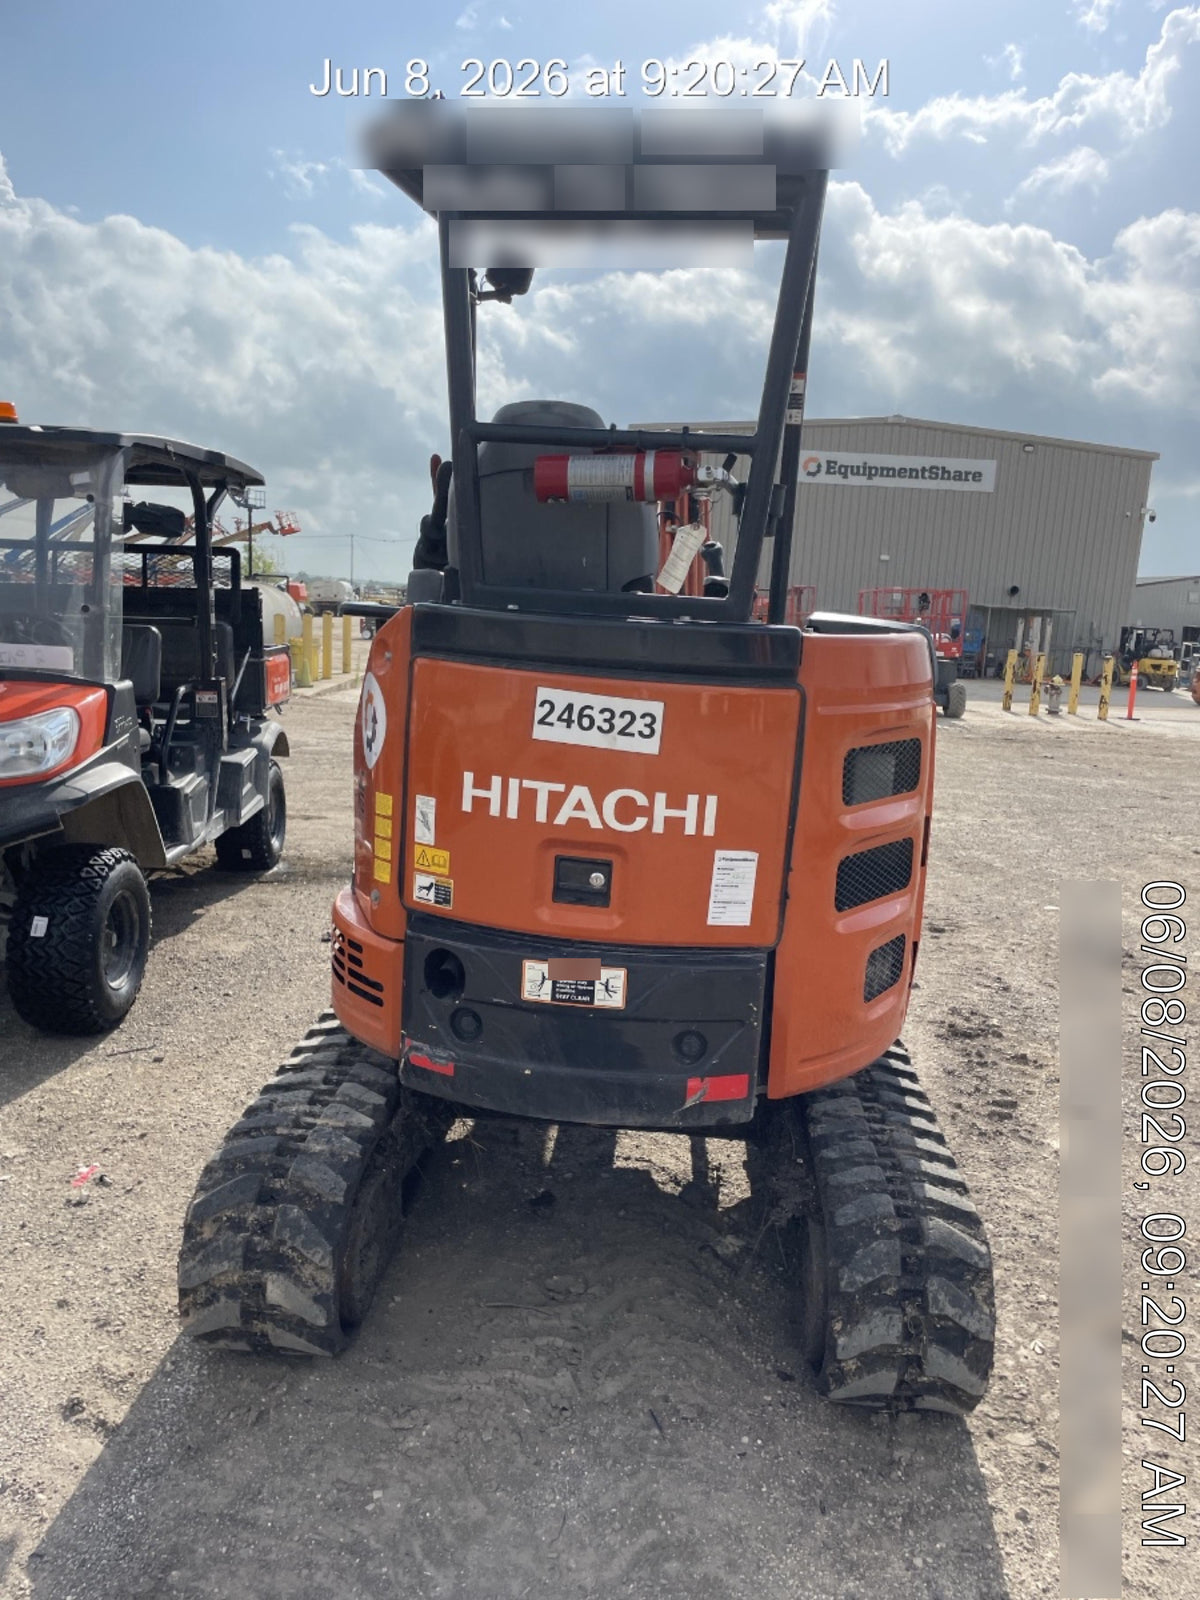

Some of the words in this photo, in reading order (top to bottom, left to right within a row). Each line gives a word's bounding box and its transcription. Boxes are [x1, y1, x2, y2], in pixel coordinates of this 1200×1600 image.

[825, 459, 983, 483] EquipmentShare
[536, 699, 657, 740] 246323
[461, 771, 718, 837] HITACHI
